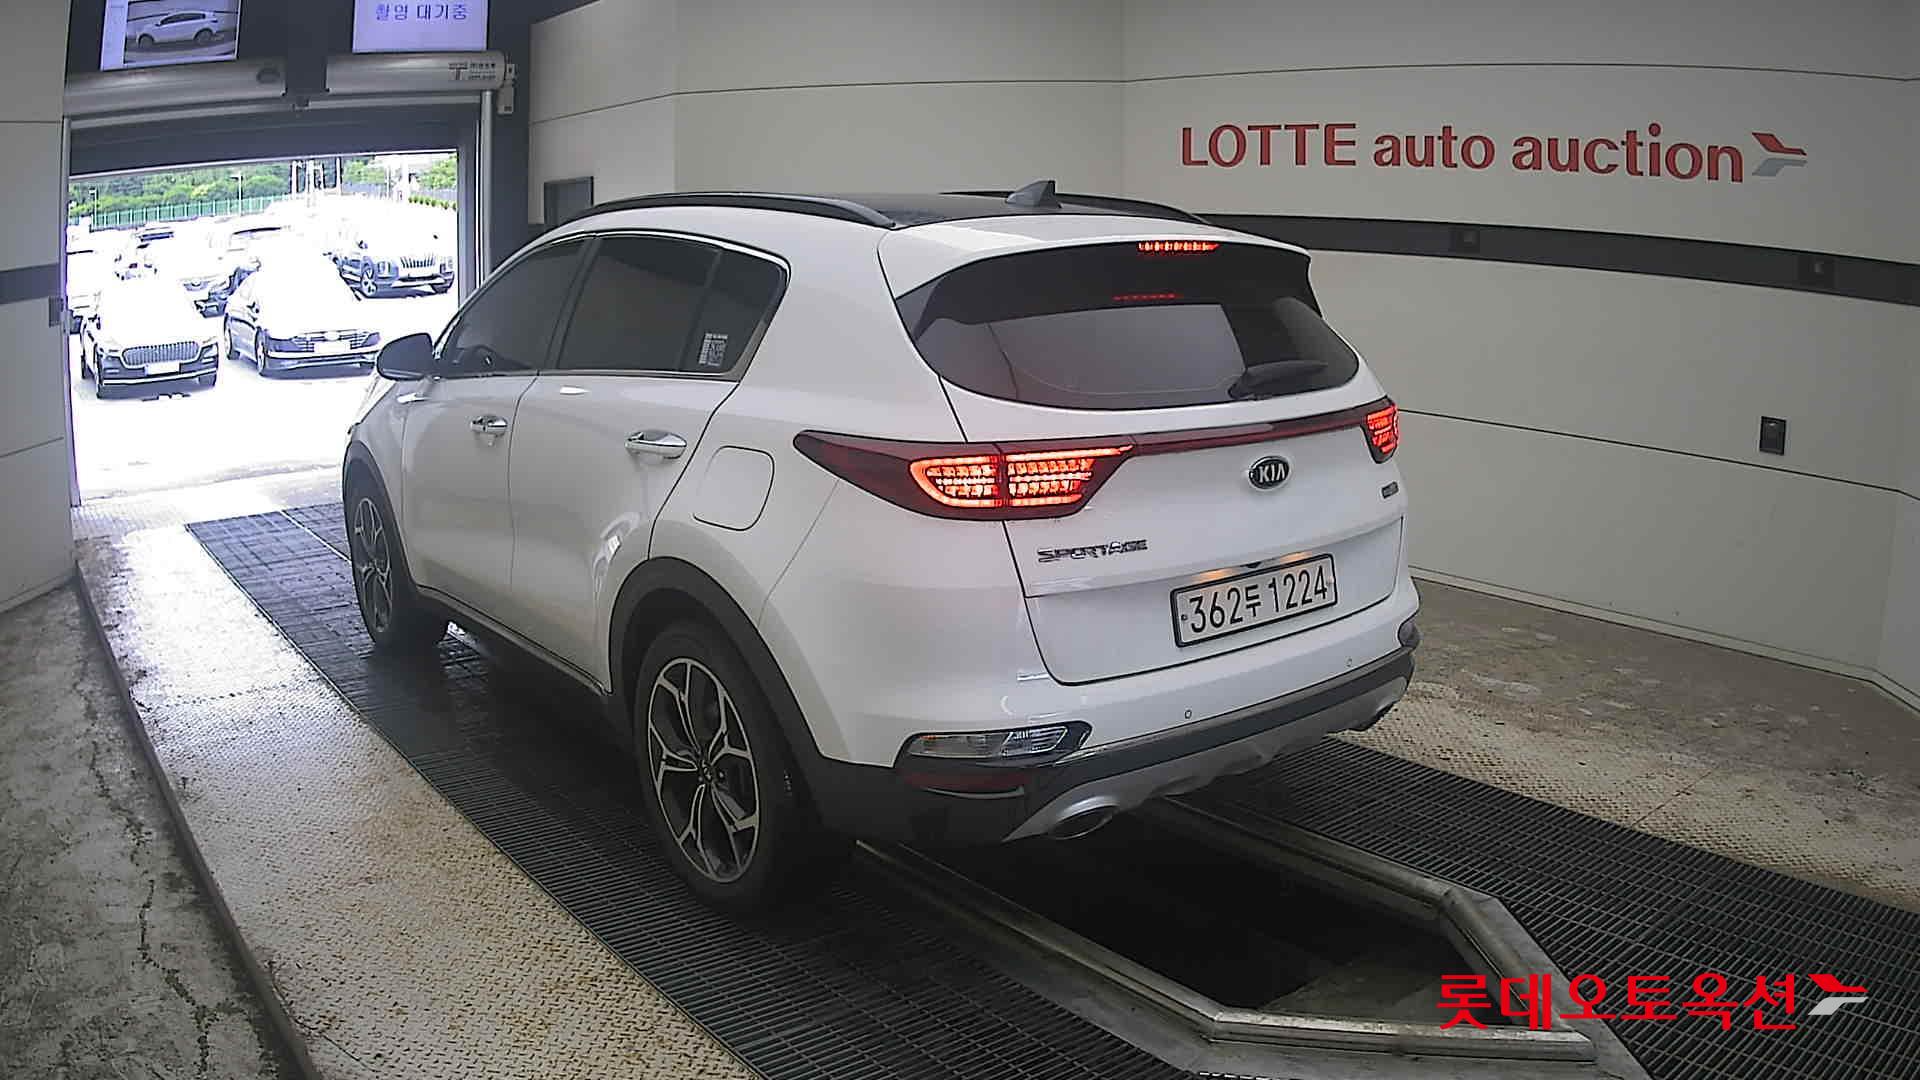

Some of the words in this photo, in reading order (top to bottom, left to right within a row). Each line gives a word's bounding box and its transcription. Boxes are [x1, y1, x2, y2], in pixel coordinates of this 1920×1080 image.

[416, 4, 467, 21] 대기중
[1182, 123, 1357, 168] LOTTE
[1373, 125, 1496, 169] auto
[1511, 122, 1744, 184] auction
[1258, 462, 1287, 484] KIA
[1037, 539, 1149, 563] SPORTAGE
[1189, 584, 1262, 633] 362두
[1268, 565, 1328, 613] 1224
